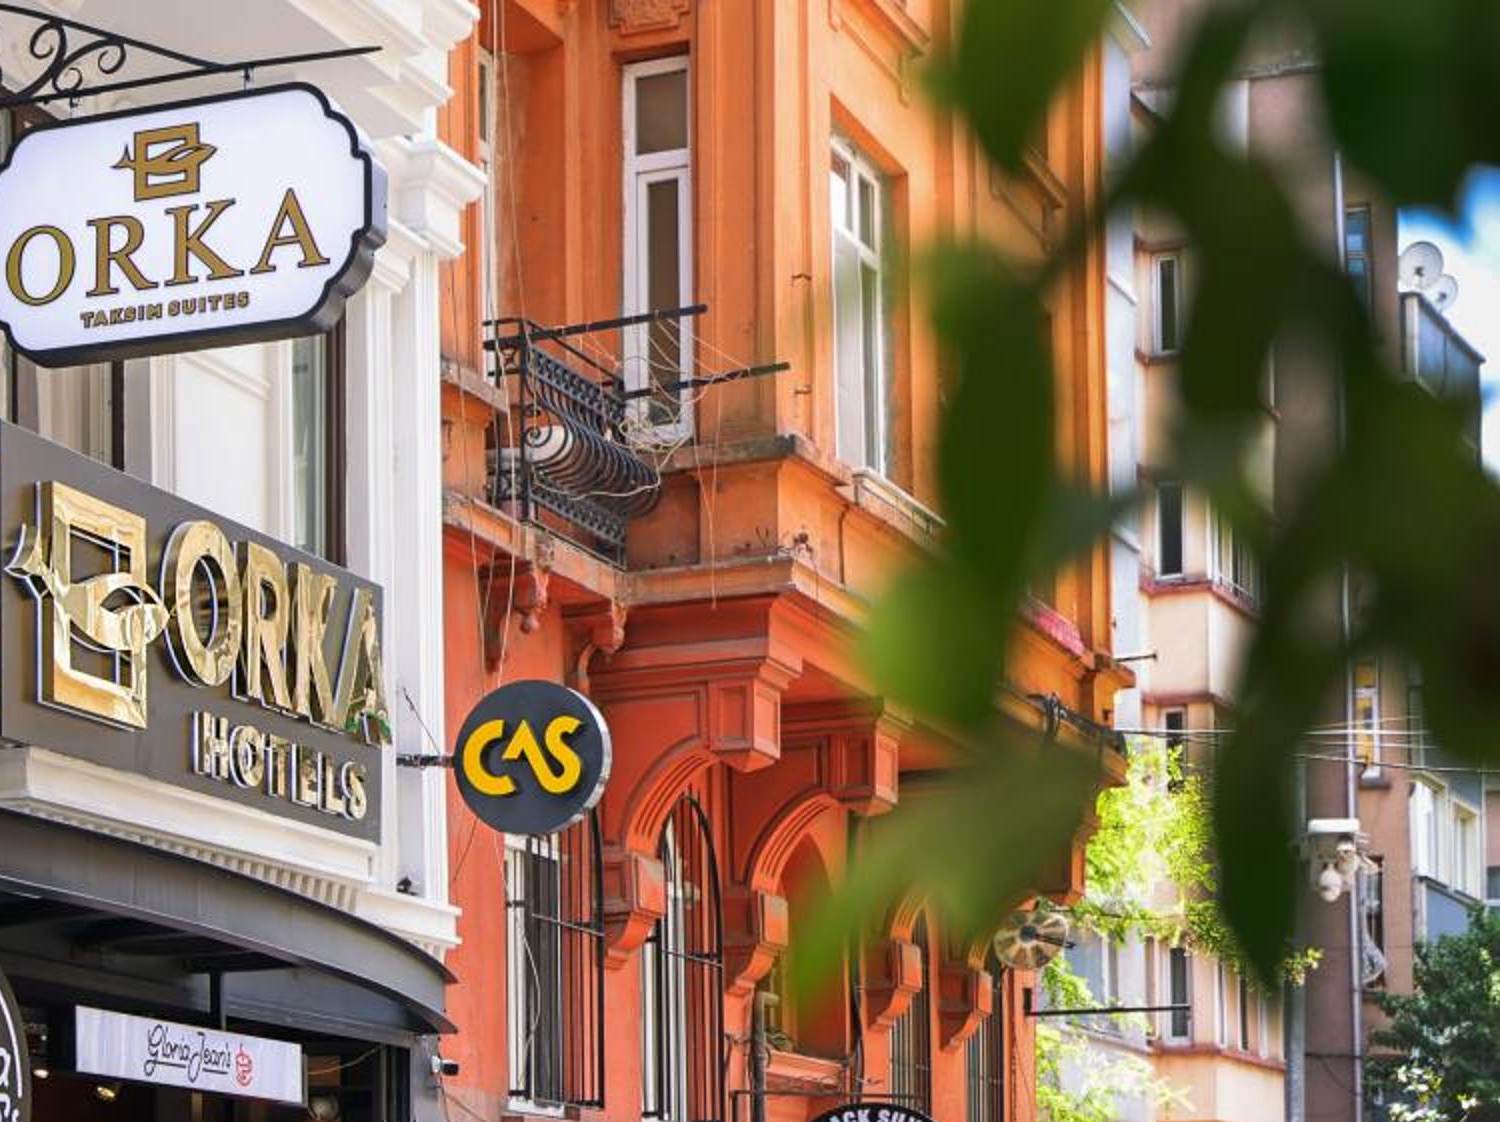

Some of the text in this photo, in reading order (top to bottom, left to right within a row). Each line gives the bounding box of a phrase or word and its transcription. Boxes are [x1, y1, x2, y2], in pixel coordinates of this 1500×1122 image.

[5, 187, 331, 306] ORKA
[80, 291, 250, 329] TAKSIM SUITES
[166, 520, 392, 746] ORKA
[192, 709, 368, 821] HOTELS
[462, 715, 583, 796] CAS
[143, 1024, 191, 1077] Gloria
